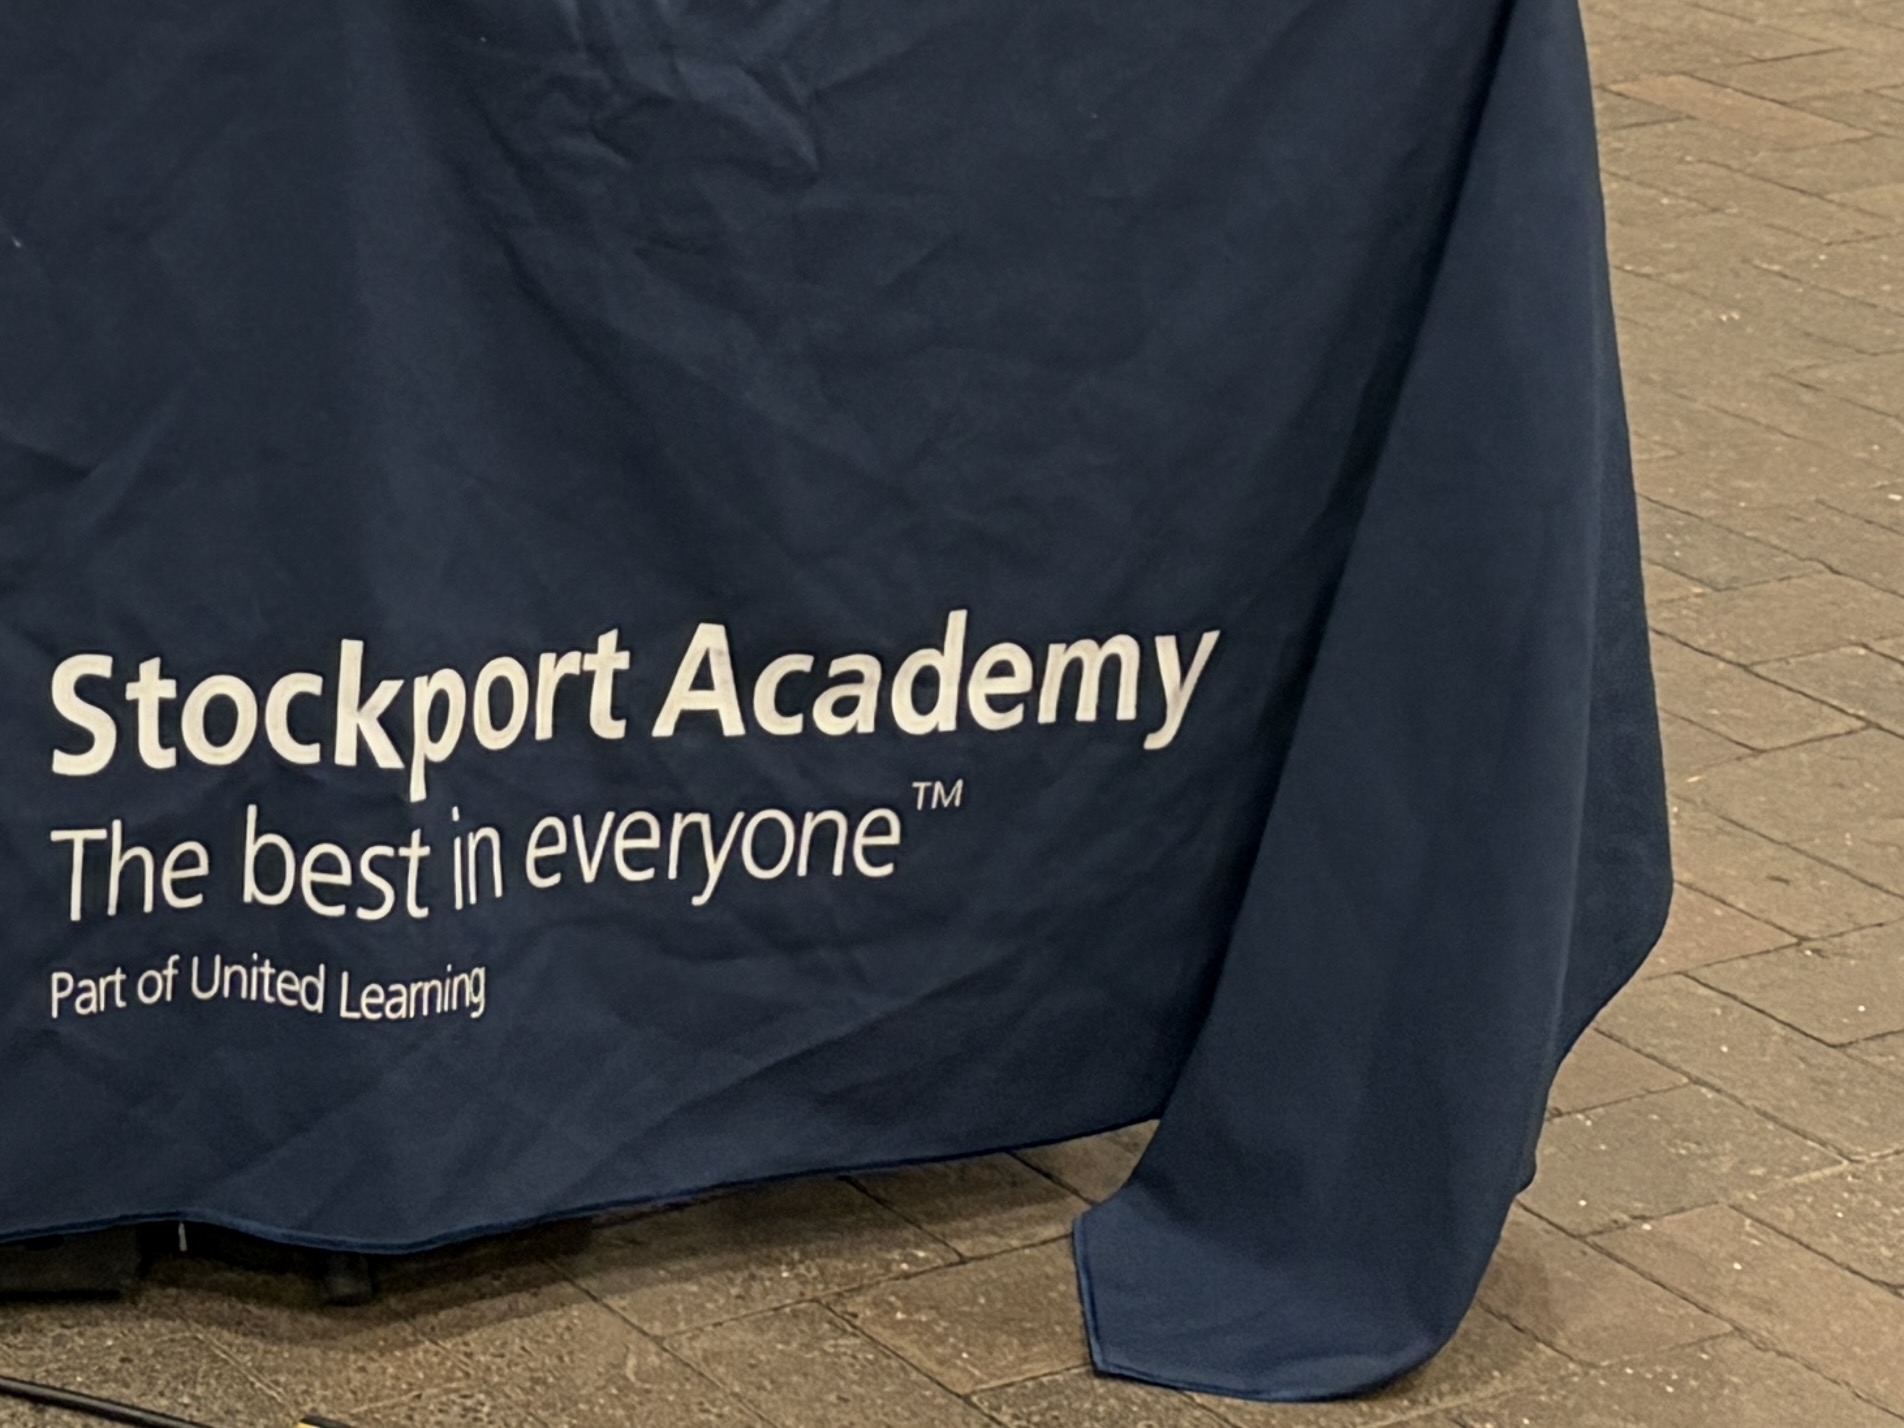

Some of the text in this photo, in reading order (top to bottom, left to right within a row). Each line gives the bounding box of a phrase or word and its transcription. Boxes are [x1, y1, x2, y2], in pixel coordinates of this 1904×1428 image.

[49, 609, 1222, 802] Stockport Academy
[50, 819, 210, 923] The
[243, 804, 432, 921] best
[451, 808, 505, 910] in
[49, 952, 488, 1021] Part of United Learning
